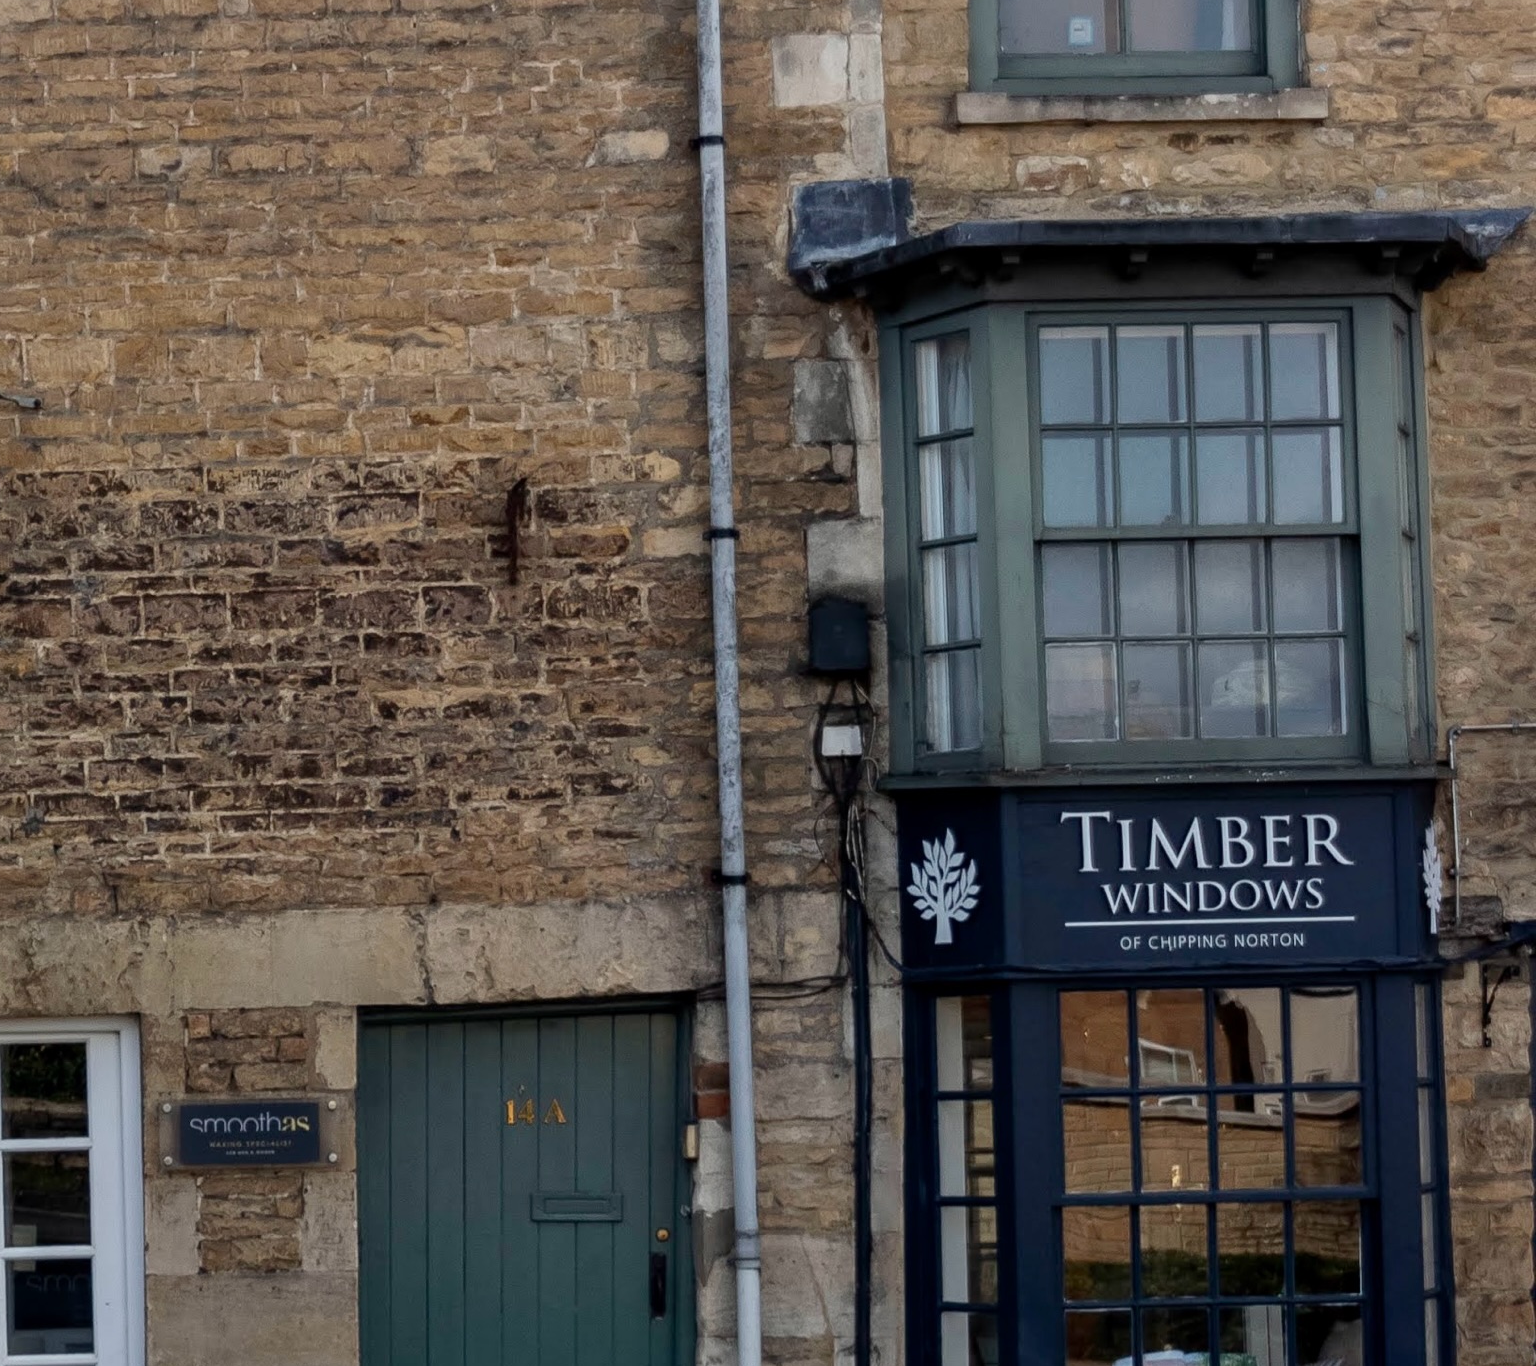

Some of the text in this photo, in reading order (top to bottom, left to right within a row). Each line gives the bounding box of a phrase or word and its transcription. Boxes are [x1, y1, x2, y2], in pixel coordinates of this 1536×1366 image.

[1060, 811, 1355, 873] TIMBER
[1100, 878, 1324, 915] WINDOWS
[1120, 933, 1305, 951] OF CHIPPING NORTON
